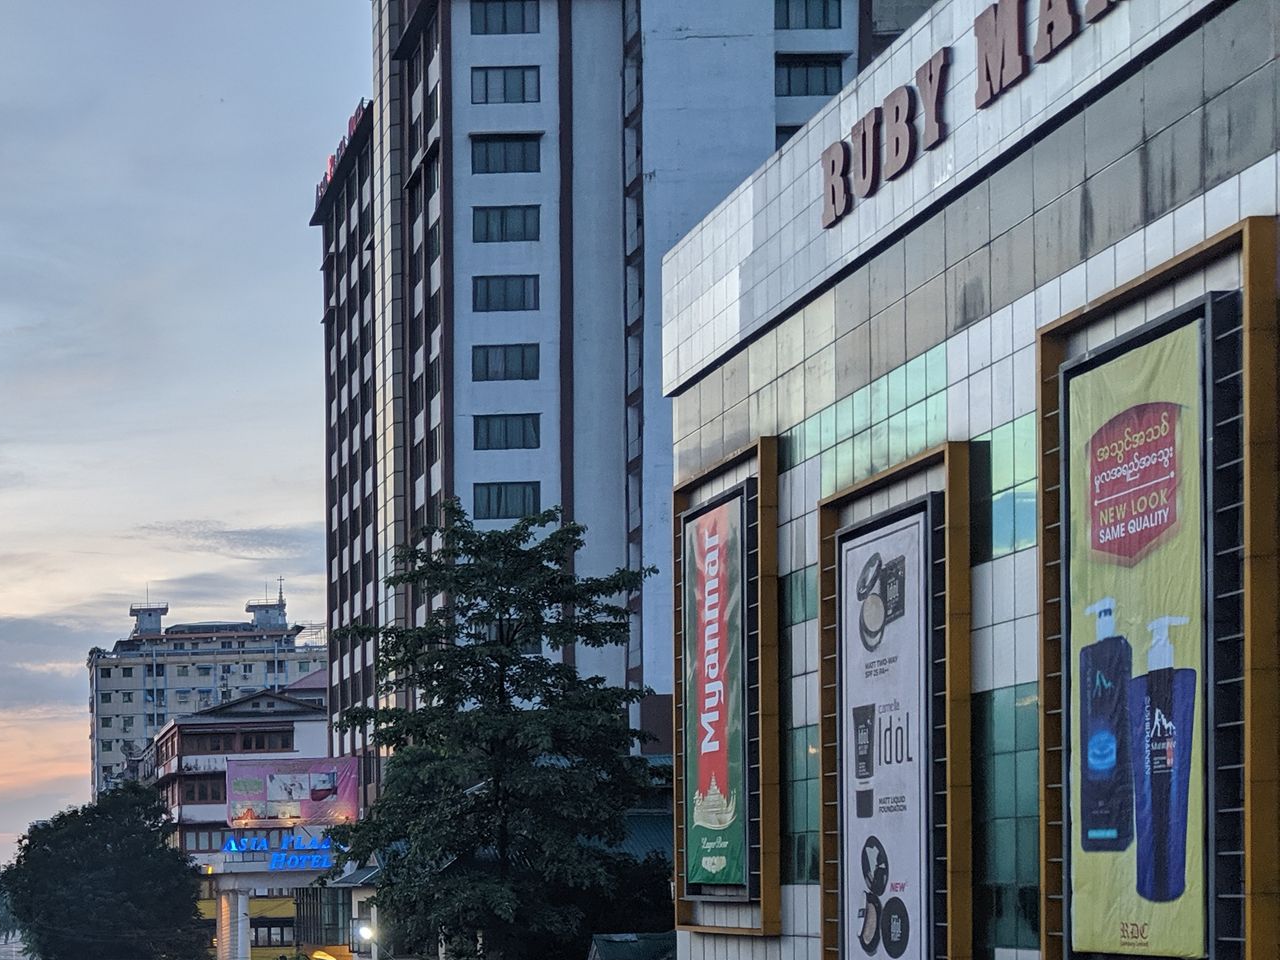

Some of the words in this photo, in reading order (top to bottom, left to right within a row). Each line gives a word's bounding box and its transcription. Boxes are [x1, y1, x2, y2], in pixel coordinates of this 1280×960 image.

[821, 46, 951, 229] RUBY
[1099, 503, 1128, 526] NEW
[1131, 488, 1169, 516] LOOK
[1099, 522, 1126, 544] SAME
[1127, 508, 1170, 532] QUALITY
[701, 528, 724, 755] Myanmar
[224, 835, 269, 852] ASIA
[268, 852, 333, 871] HOTEL
